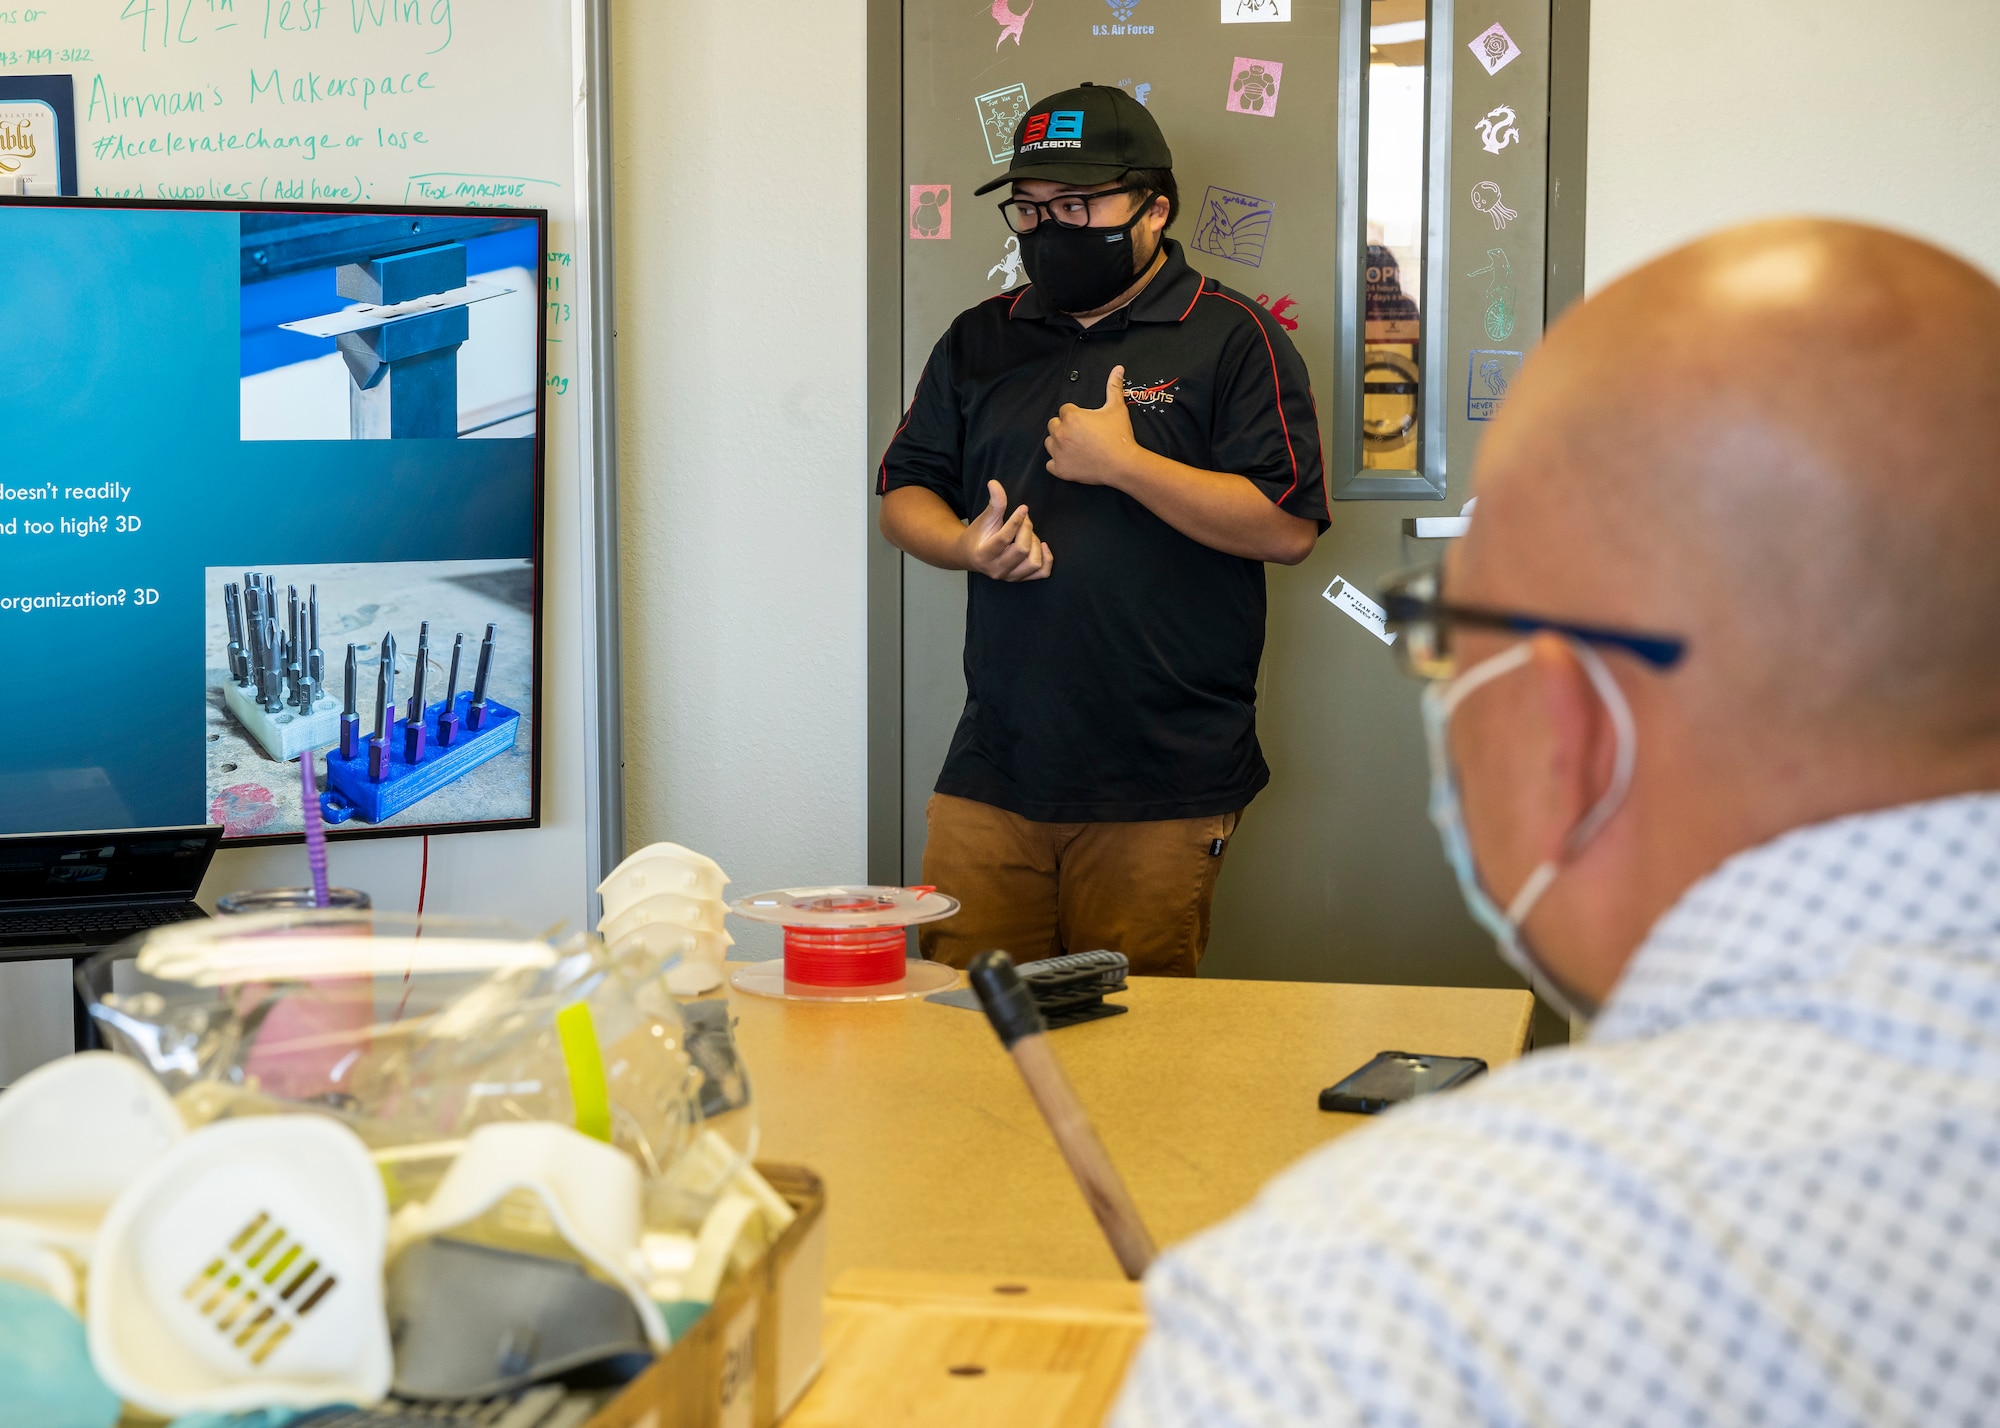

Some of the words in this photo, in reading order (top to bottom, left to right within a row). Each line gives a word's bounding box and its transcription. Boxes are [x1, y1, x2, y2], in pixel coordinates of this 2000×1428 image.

[24, 9, 47, 23] or
[351, 0, 452, 54] Wing
[1092, 24, 1110, 36] U.S.
[1111, 24, 1126, 36] Air
[1127, 23, 1155, 35] Force
[1117, 78, 1132, 88] 404
[88, 73, 224, 124] Airman's
[250, 68, 437, 110] Makerspace
[377, 127, 429, 149] lose
[1020, 140, 1082, 153] BATTLEBOTS
[158, 178, 252, 200] supplies
[1471, 401, 1493, 410] NEVER
[65, 482, 131, 503] readily
[24, 520, 54, 535] too
[60, 515, 109, 538] high?
[115, 515, 142, 533] 3D
[0, 588, 127, 613] organization?
[133, 588, 160, 606] 3D
